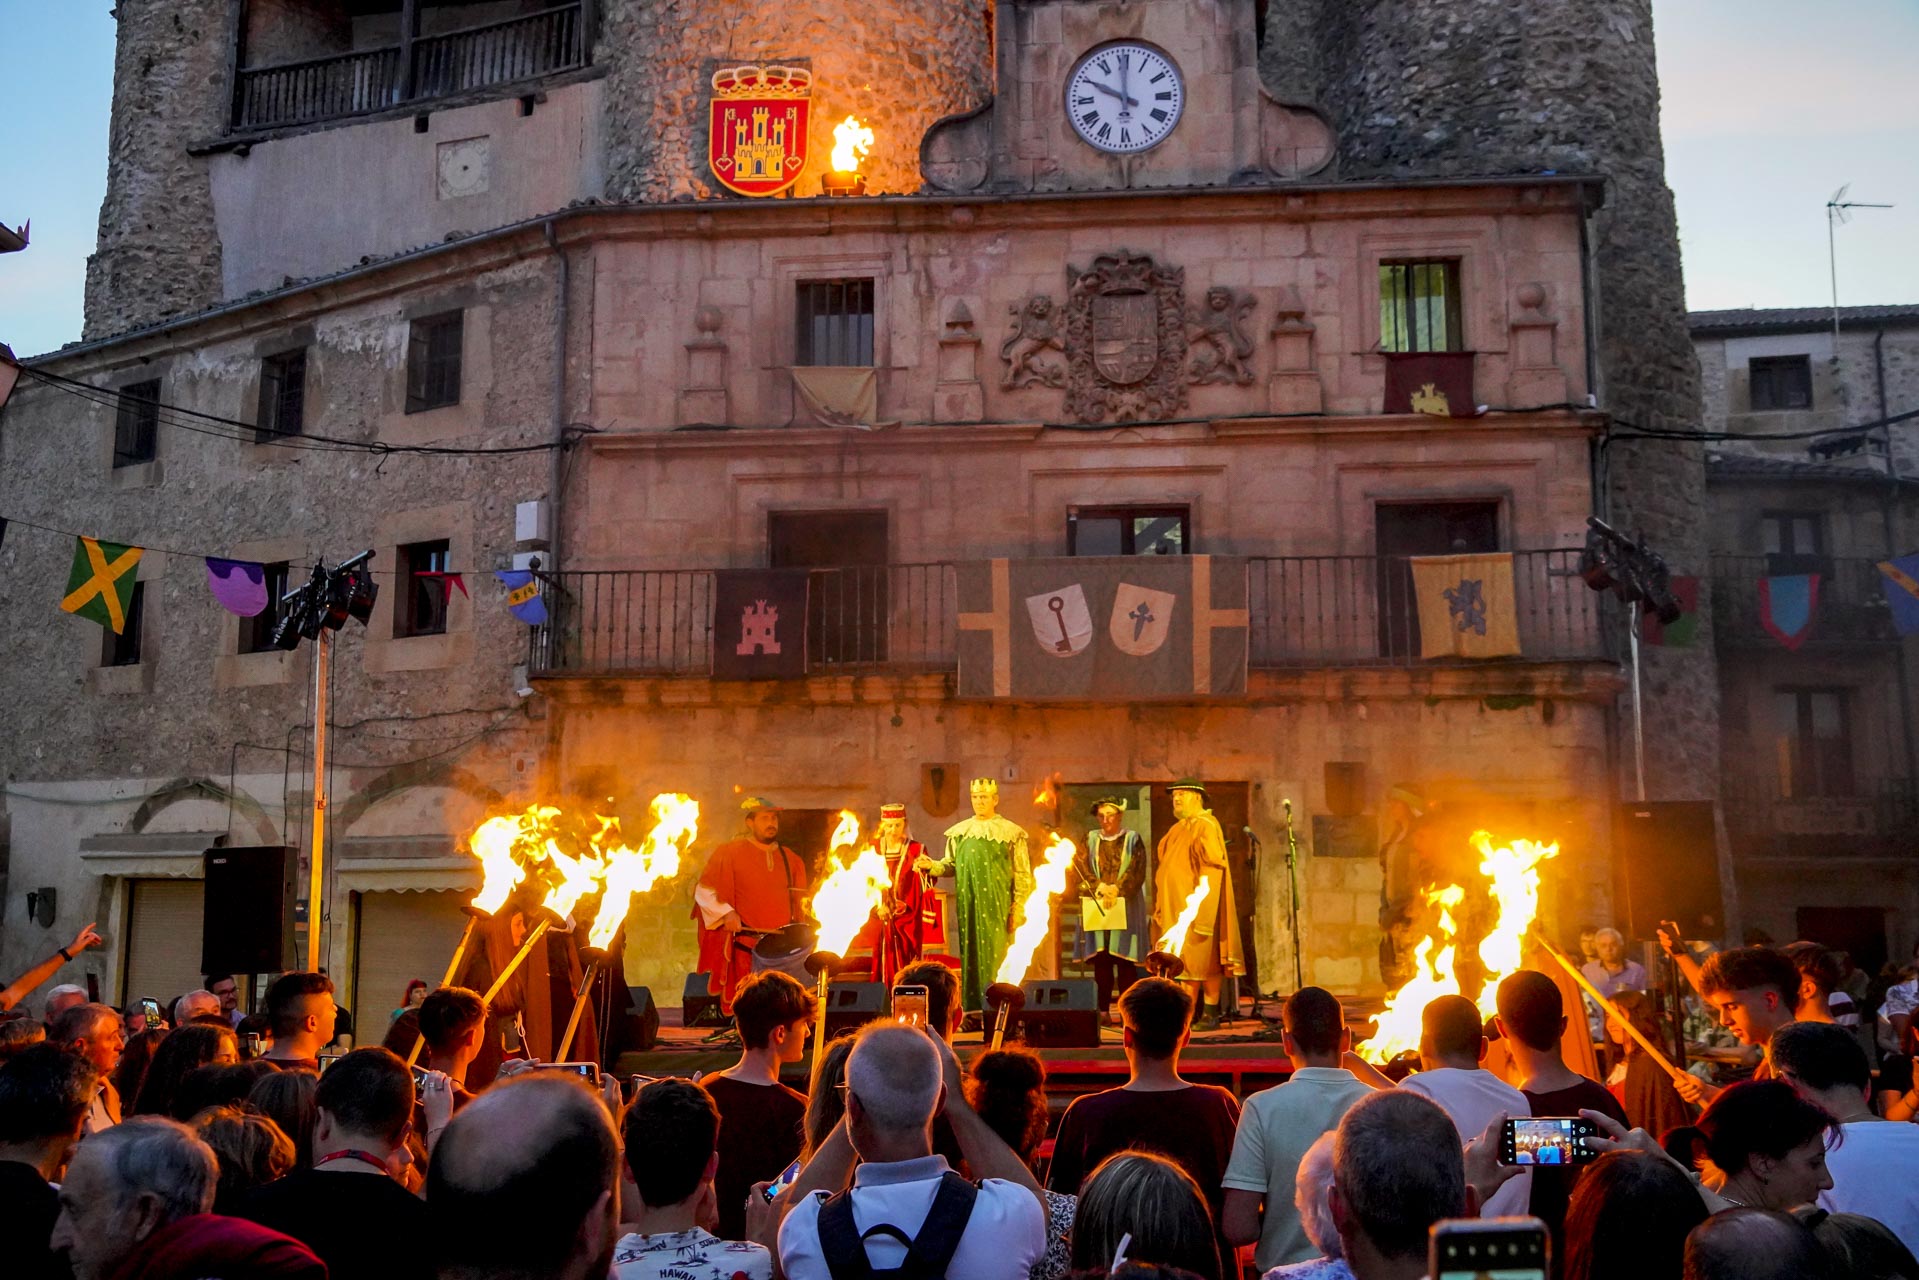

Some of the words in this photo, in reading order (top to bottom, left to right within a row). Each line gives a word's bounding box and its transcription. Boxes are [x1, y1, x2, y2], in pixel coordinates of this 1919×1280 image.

[1097, 59, 1112, 76] XI
[1138, 58, 1147, 72] I
[1149, 72, 1166, 84] II
[1121, 127, 1131, 143] VI
[1141, 123, 1152, 136] V
